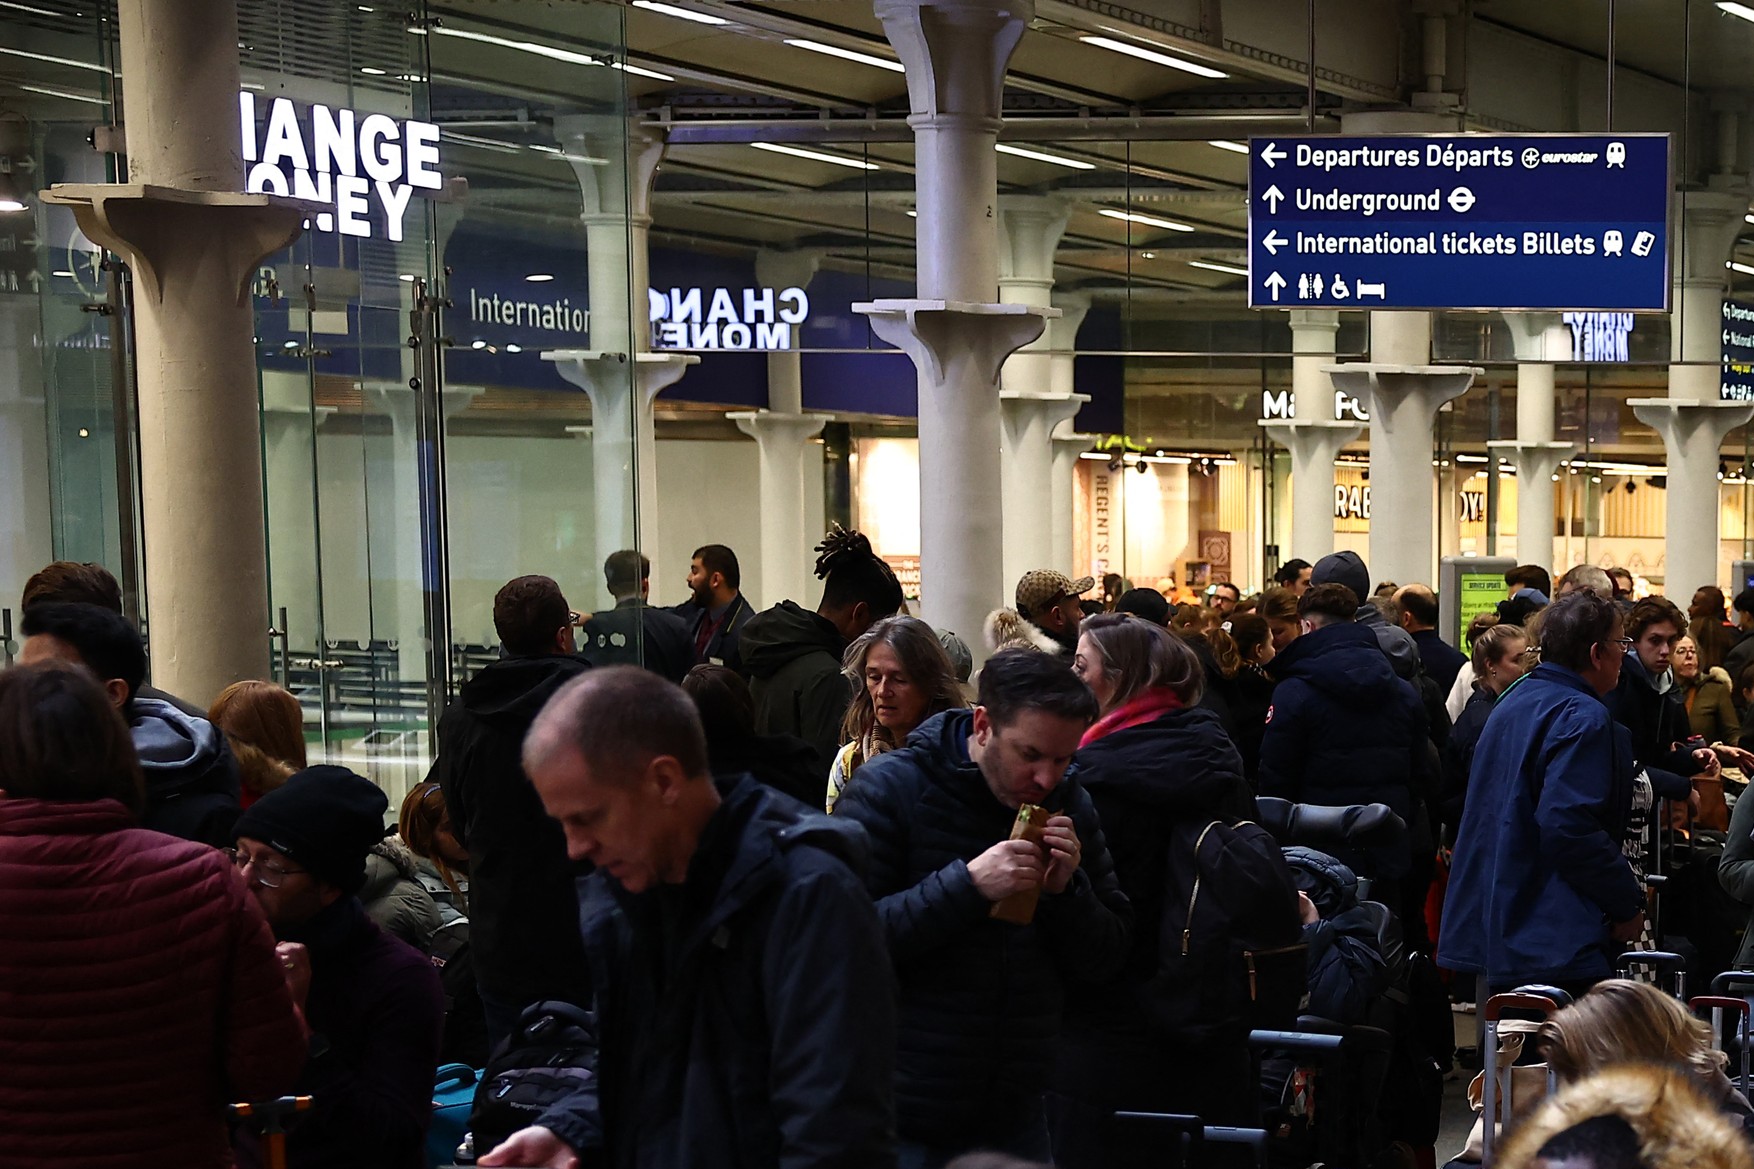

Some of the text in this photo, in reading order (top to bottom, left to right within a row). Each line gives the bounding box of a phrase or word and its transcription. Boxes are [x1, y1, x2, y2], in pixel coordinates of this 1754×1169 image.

[1296, 143, 1598, 172] Departures Départs eurostar
[245, 162, 413, 242] ONEY
[1296, 188, 1440, 216] Underground
[1297, 231, 1596, 255] International tickets Billets
